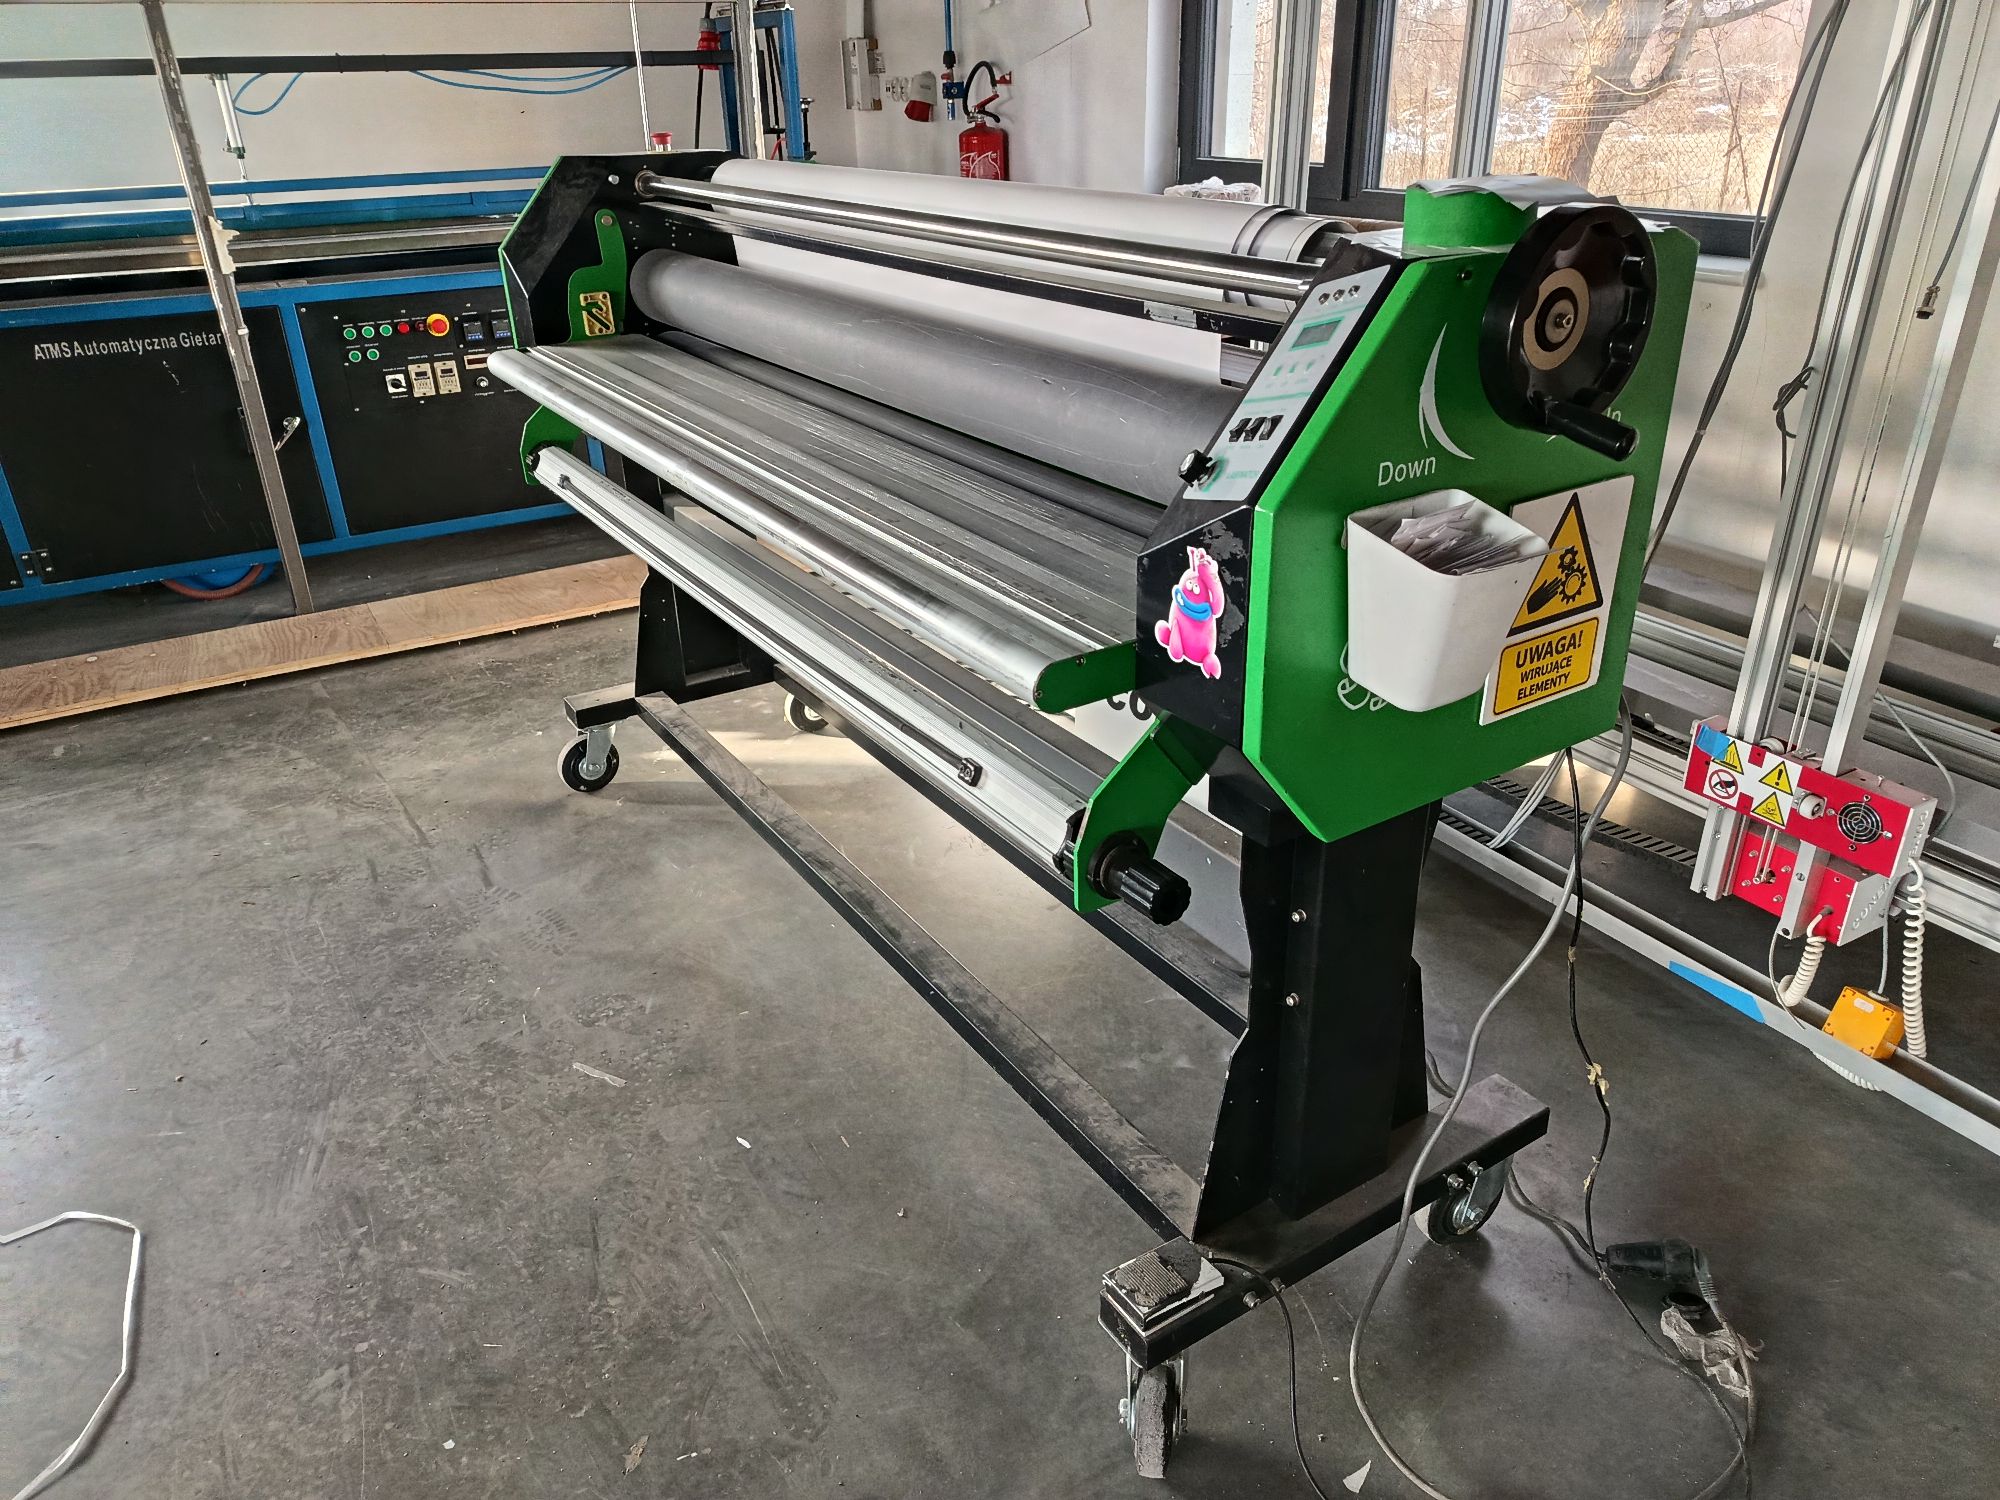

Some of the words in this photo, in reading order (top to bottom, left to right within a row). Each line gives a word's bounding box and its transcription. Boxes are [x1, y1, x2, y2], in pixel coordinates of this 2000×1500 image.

[34, 341, 72, 361] ATMS
[73, 336, 178, 356] Automatyczna
[179, 331, 222, 348] Gietar
[1377, 456, 1437, 487] Down
[1515, 629, 1583, 669] UWAGA!
[1519, 655, 1573, 684] WIRUJĄCE
[1516, 671, 1571, 701] ELEMENTY
